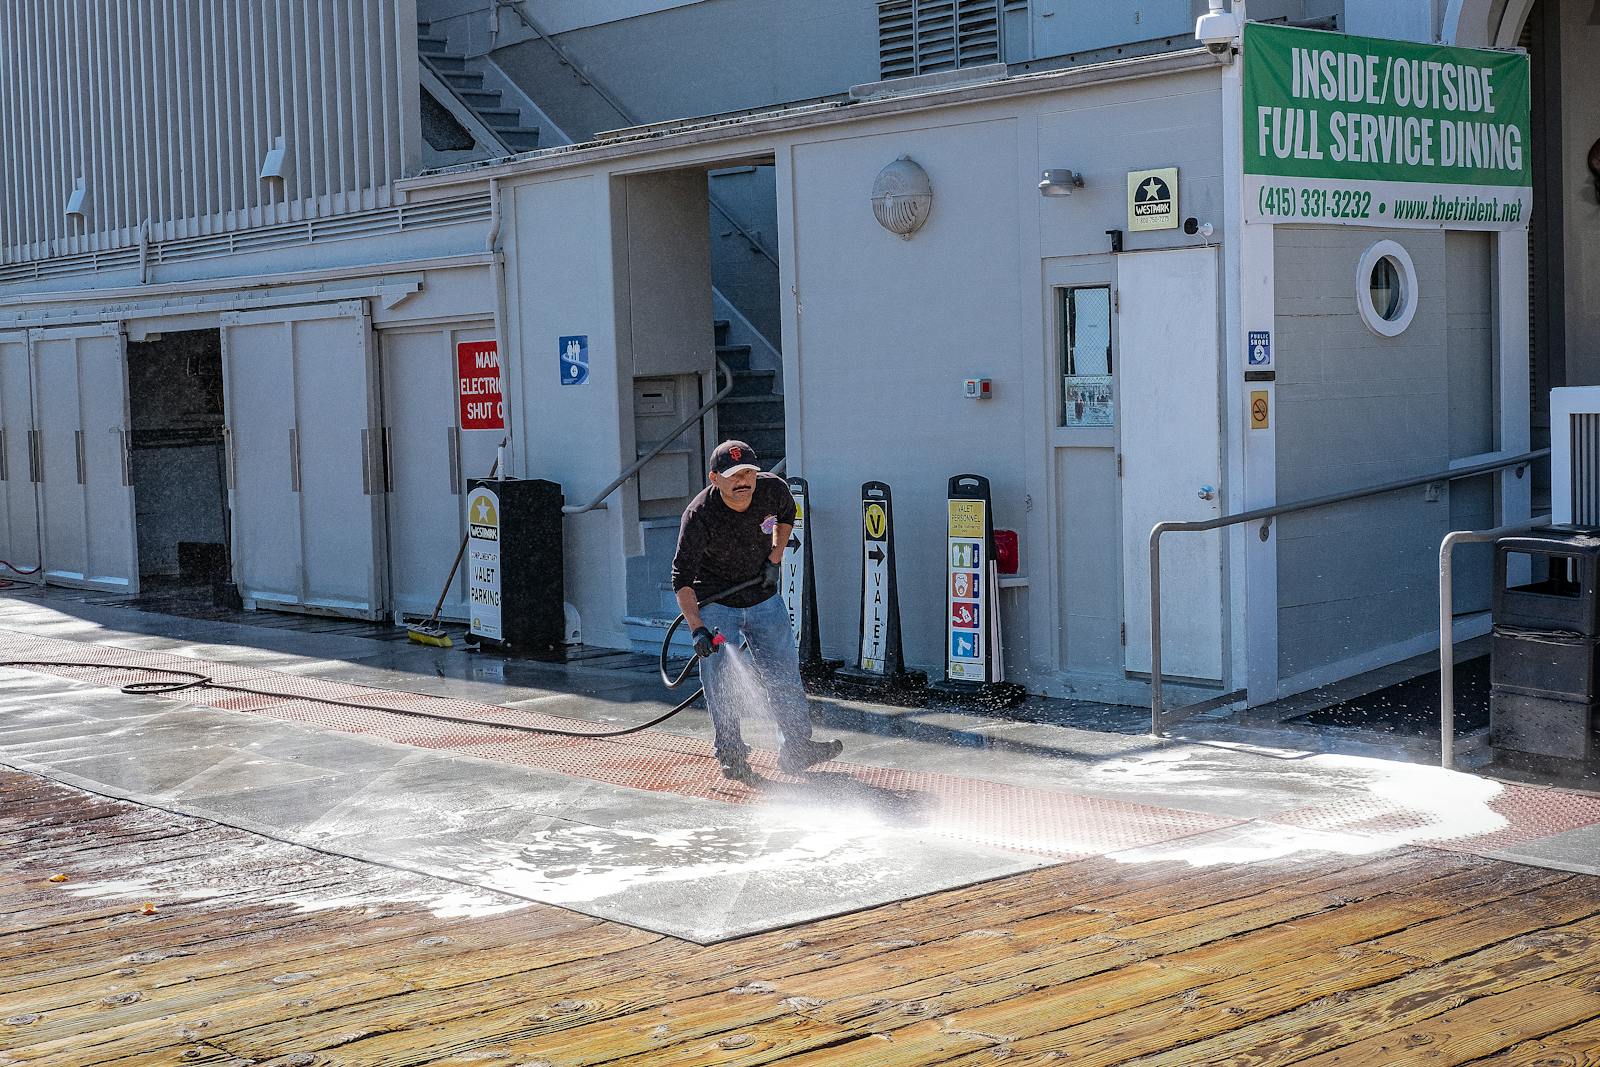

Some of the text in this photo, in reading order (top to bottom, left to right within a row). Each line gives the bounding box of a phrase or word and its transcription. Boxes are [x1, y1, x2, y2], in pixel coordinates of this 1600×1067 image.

[1291, 47, 1495, 113] INSIDE/OUTSIDE
[1257, 106, 1522, 171] FULL SERVICE DINING
[1135, 202, 1170, 216] WESTPARK
[1258, 185, 1523, 222] (415) 331-3232 www.thetrident.net
[475, 350, 500, 369] MAIN
[467, 402, 492, 420] SHUT
[869, 514, 881, 535] V
[473, 566, 495, 584] VALET
[471, 586, 500, 607] PARKING
[872, 572, 882, 656] VALET
